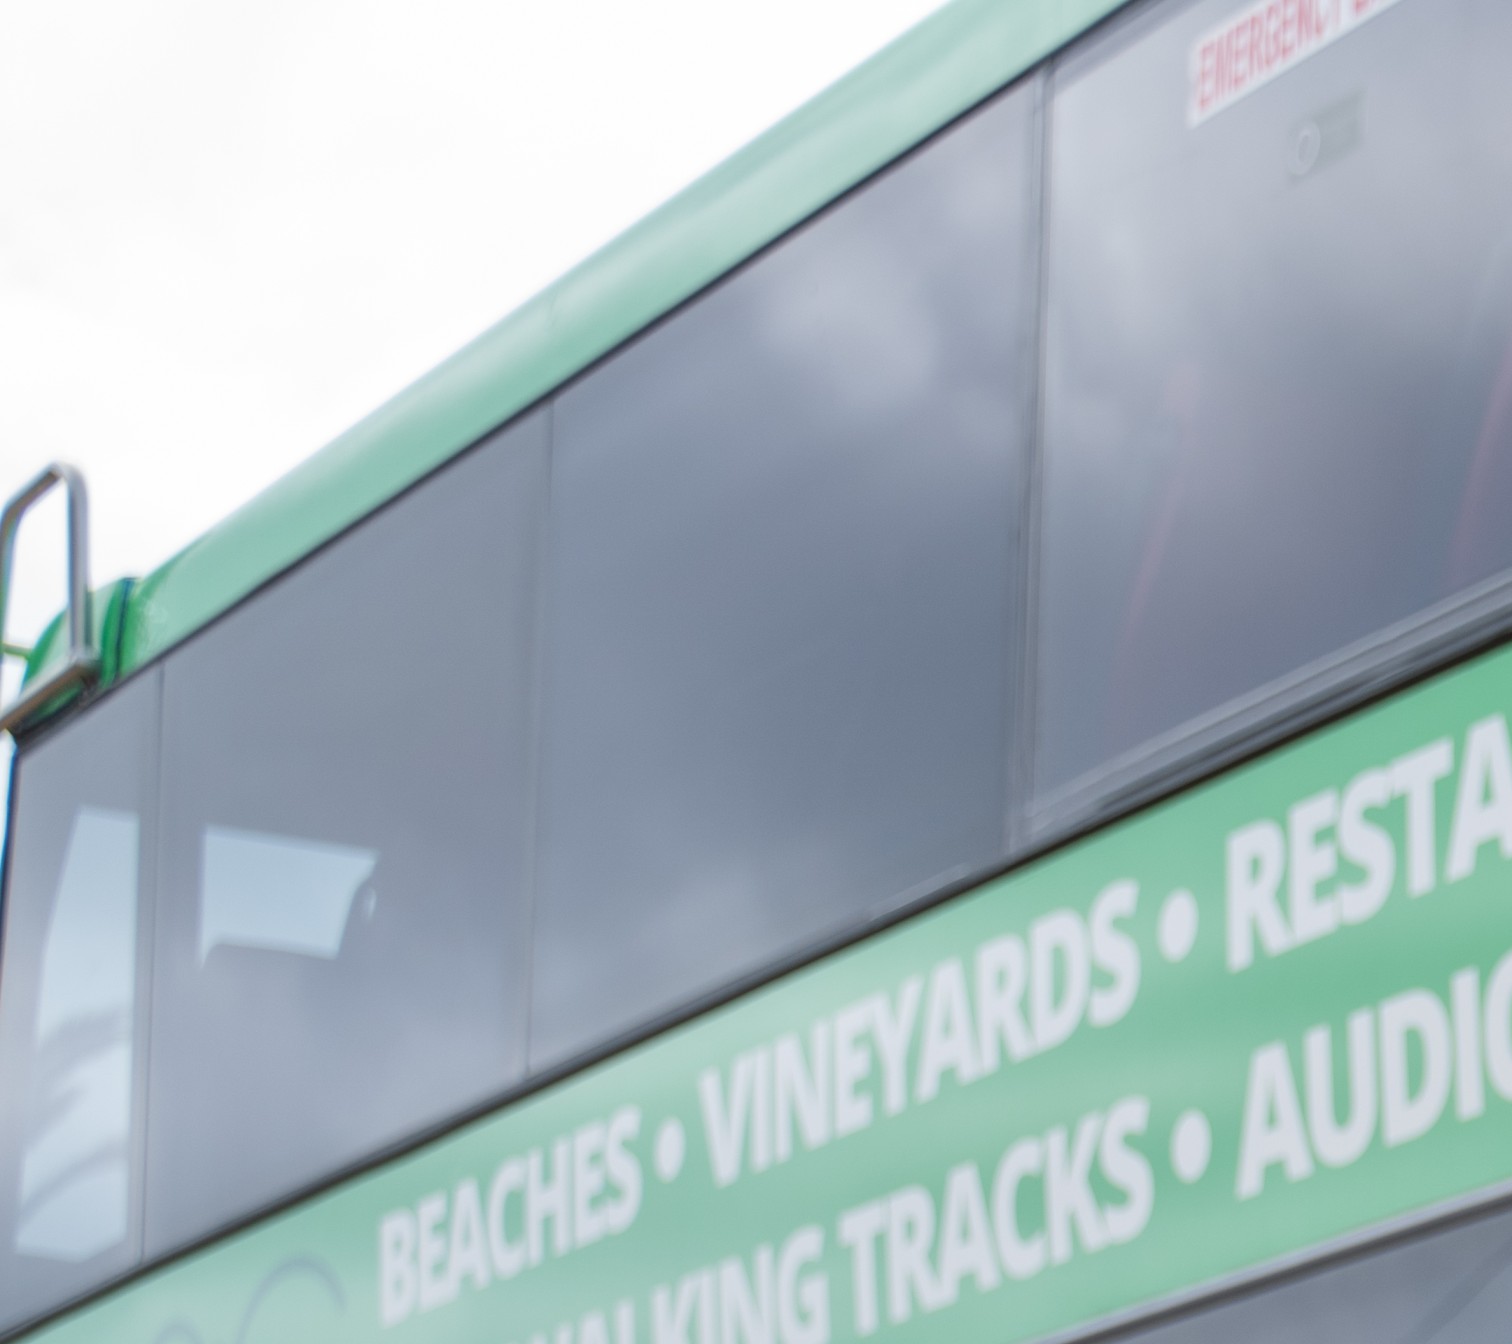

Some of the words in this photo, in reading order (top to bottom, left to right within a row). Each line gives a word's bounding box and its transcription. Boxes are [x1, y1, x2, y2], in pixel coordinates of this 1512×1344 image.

[378, 1105, 645, 1330] BEACHES
[700, 879, 1141, 1187] VINEYARDS
[838, 1096, 1155, 1338] TRACKS
